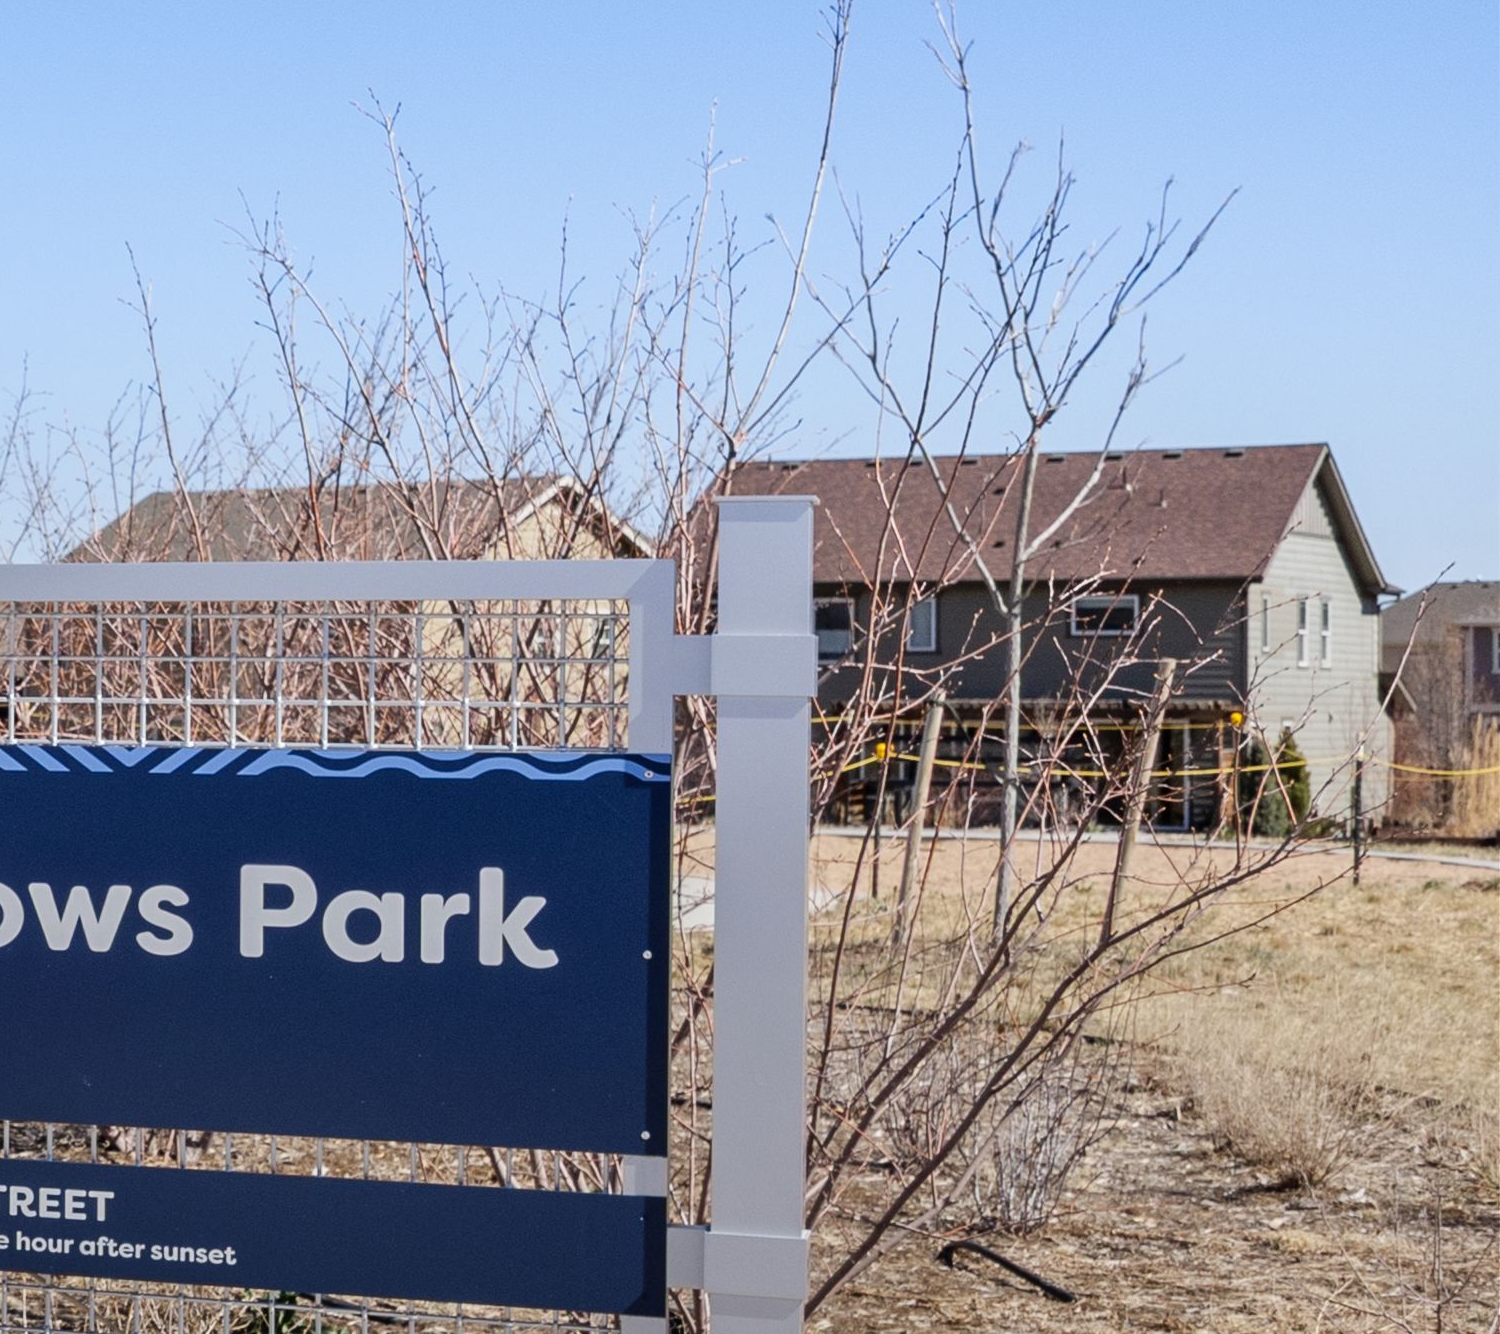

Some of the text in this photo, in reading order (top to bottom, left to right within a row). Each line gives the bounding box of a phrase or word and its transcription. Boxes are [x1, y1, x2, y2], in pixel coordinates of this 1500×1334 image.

[239, 864, 559, 969] Park
[16, 1230, 75, 1254] hour
[78, 1236, 146, 1259] after
[150, 1244, 237, 1266] sunset
